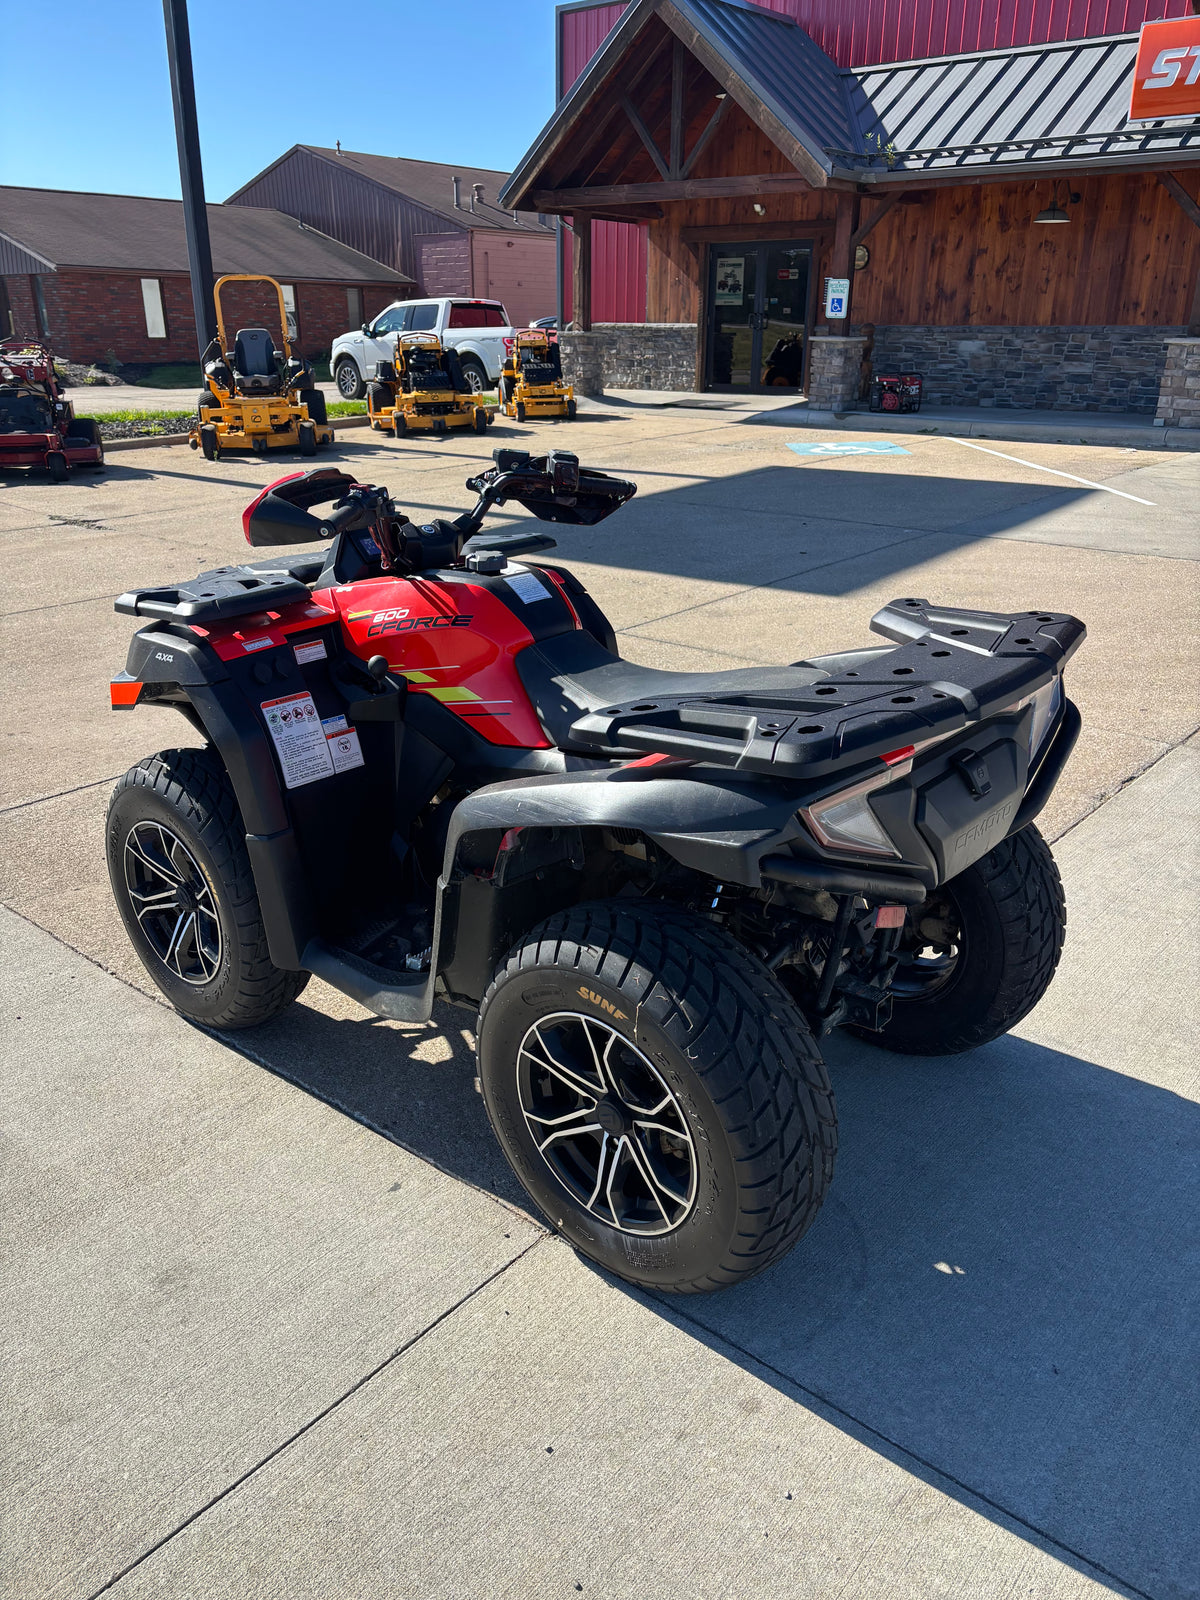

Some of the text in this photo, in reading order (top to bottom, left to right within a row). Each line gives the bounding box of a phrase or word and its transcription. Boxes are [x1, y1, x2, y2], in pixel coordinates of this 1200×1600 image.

[367, 615, 474, 637] CFORCE
[373, 609, 409, 623] 600
[954, 801, 1012, 853] CFMOTO
[576, 986, 629, 1020] SUNF
